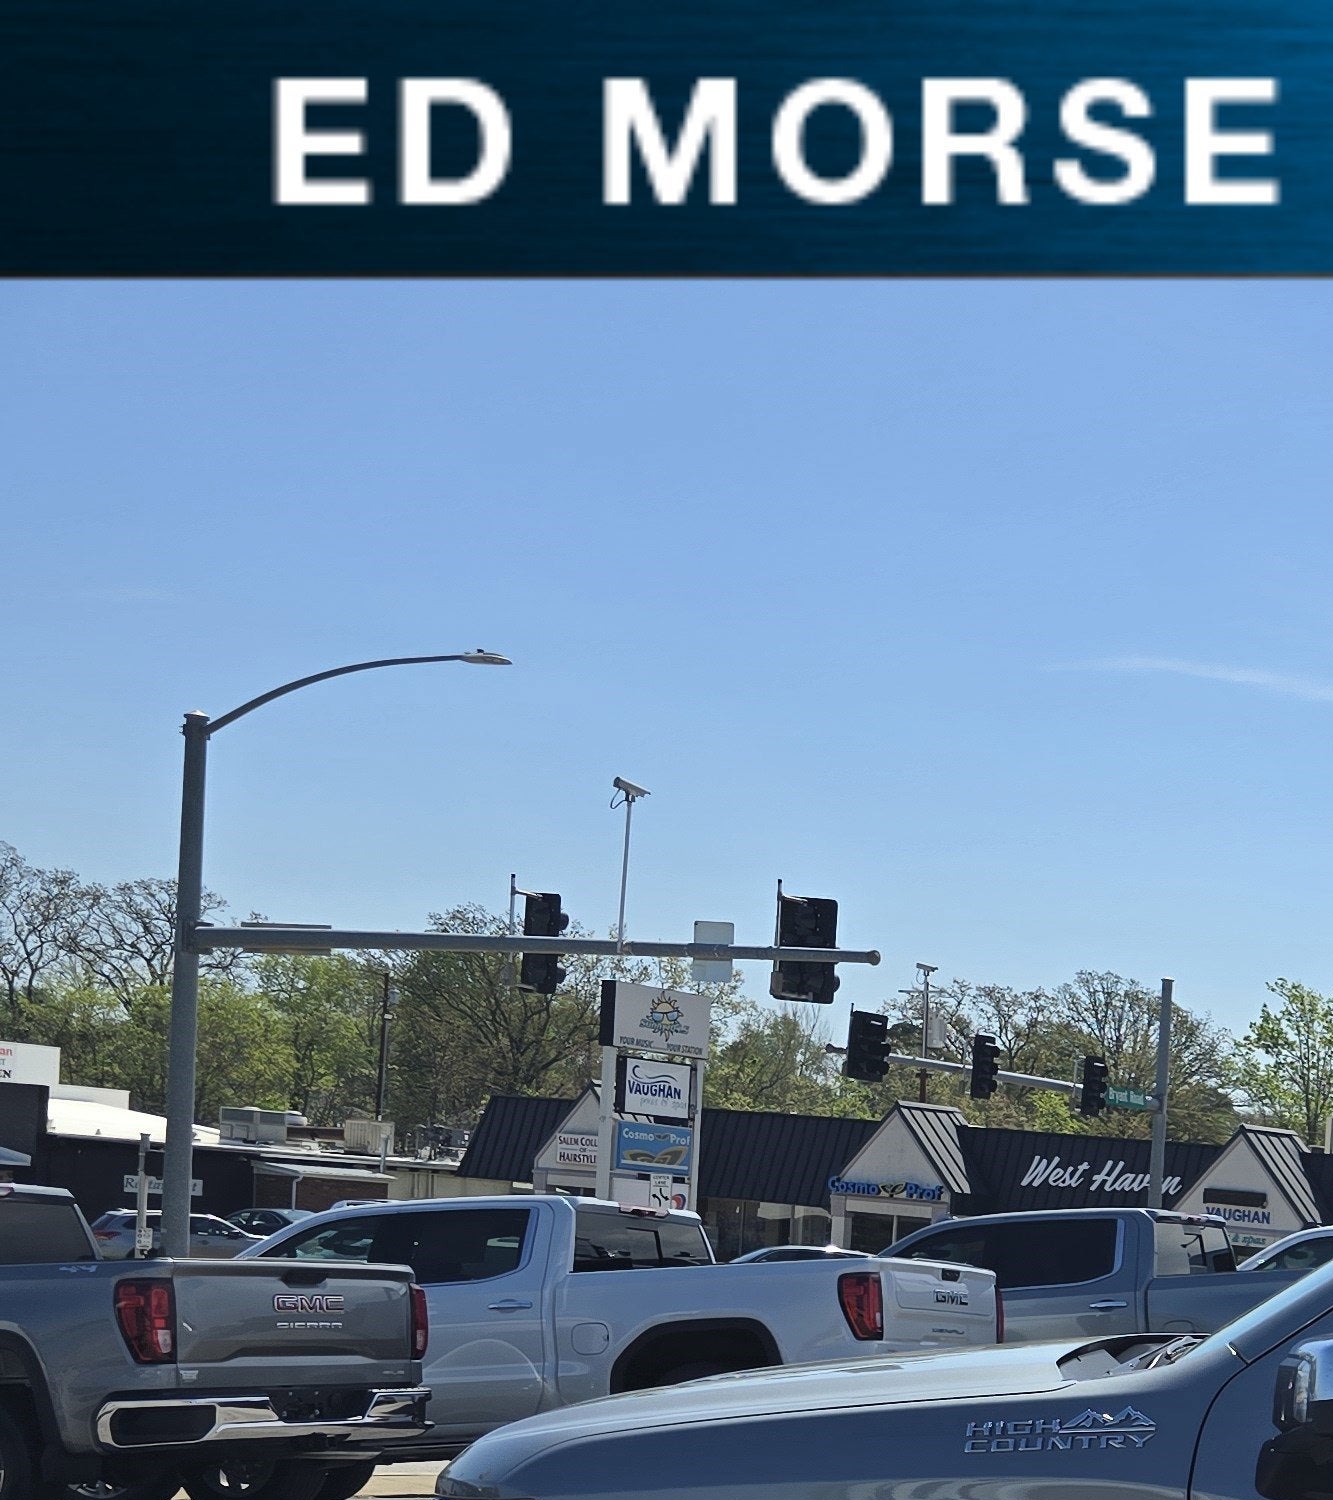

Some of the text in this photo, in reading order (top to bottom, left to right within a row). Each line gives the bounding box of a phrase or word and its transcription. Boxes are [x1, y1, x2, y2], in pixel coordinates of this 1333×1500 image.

[681, 1044, 703, 1055] STATION
[628, 1080, 682, 1100] VAUGHAN
[559, 1135, 579, 1146] SALEM
[623, 1128, 691, 1146] Cosmo Prof
[1020, 1155, 1182, 1195] West Havn
[828, 1176, 944, 1201] Cosmo Prof
[1206, 1206, 1271, 1224] VAUGHAN
[273, 1294, 345, 1314] GMC
[933, 1289, 969, 1306] GMC
[965, 1418, 1062, 1438] HIGH
[964, 1433, 1157, 1453] COUNTRY
